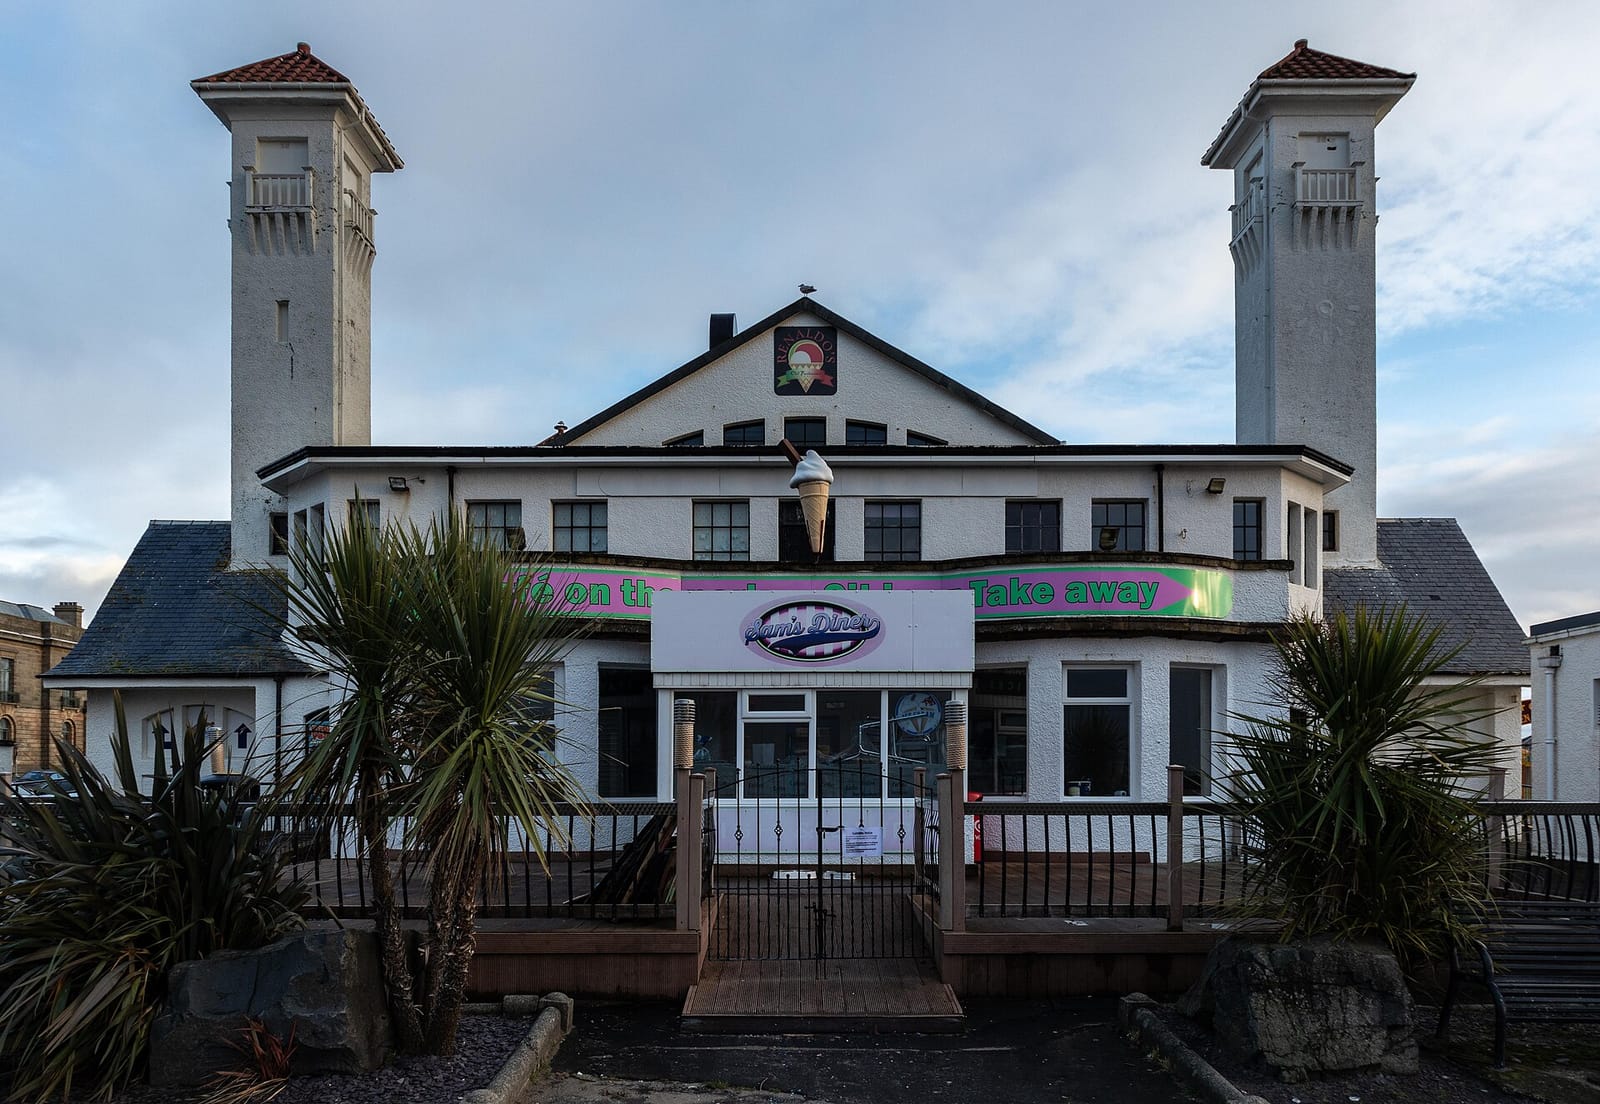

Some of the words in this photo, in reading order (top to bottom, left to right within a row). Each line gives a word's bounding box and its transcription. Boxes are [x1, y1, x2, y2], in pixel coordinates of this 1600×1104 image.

[564, 582, 611, 606] on
[619, 578, 673, 608] th
[968, 577, 1055, 608] Take
[1064, 580, 1160, 610] away
[744, 615, 804, 646] Sam's
[806, 612, 878, 636] Diner
